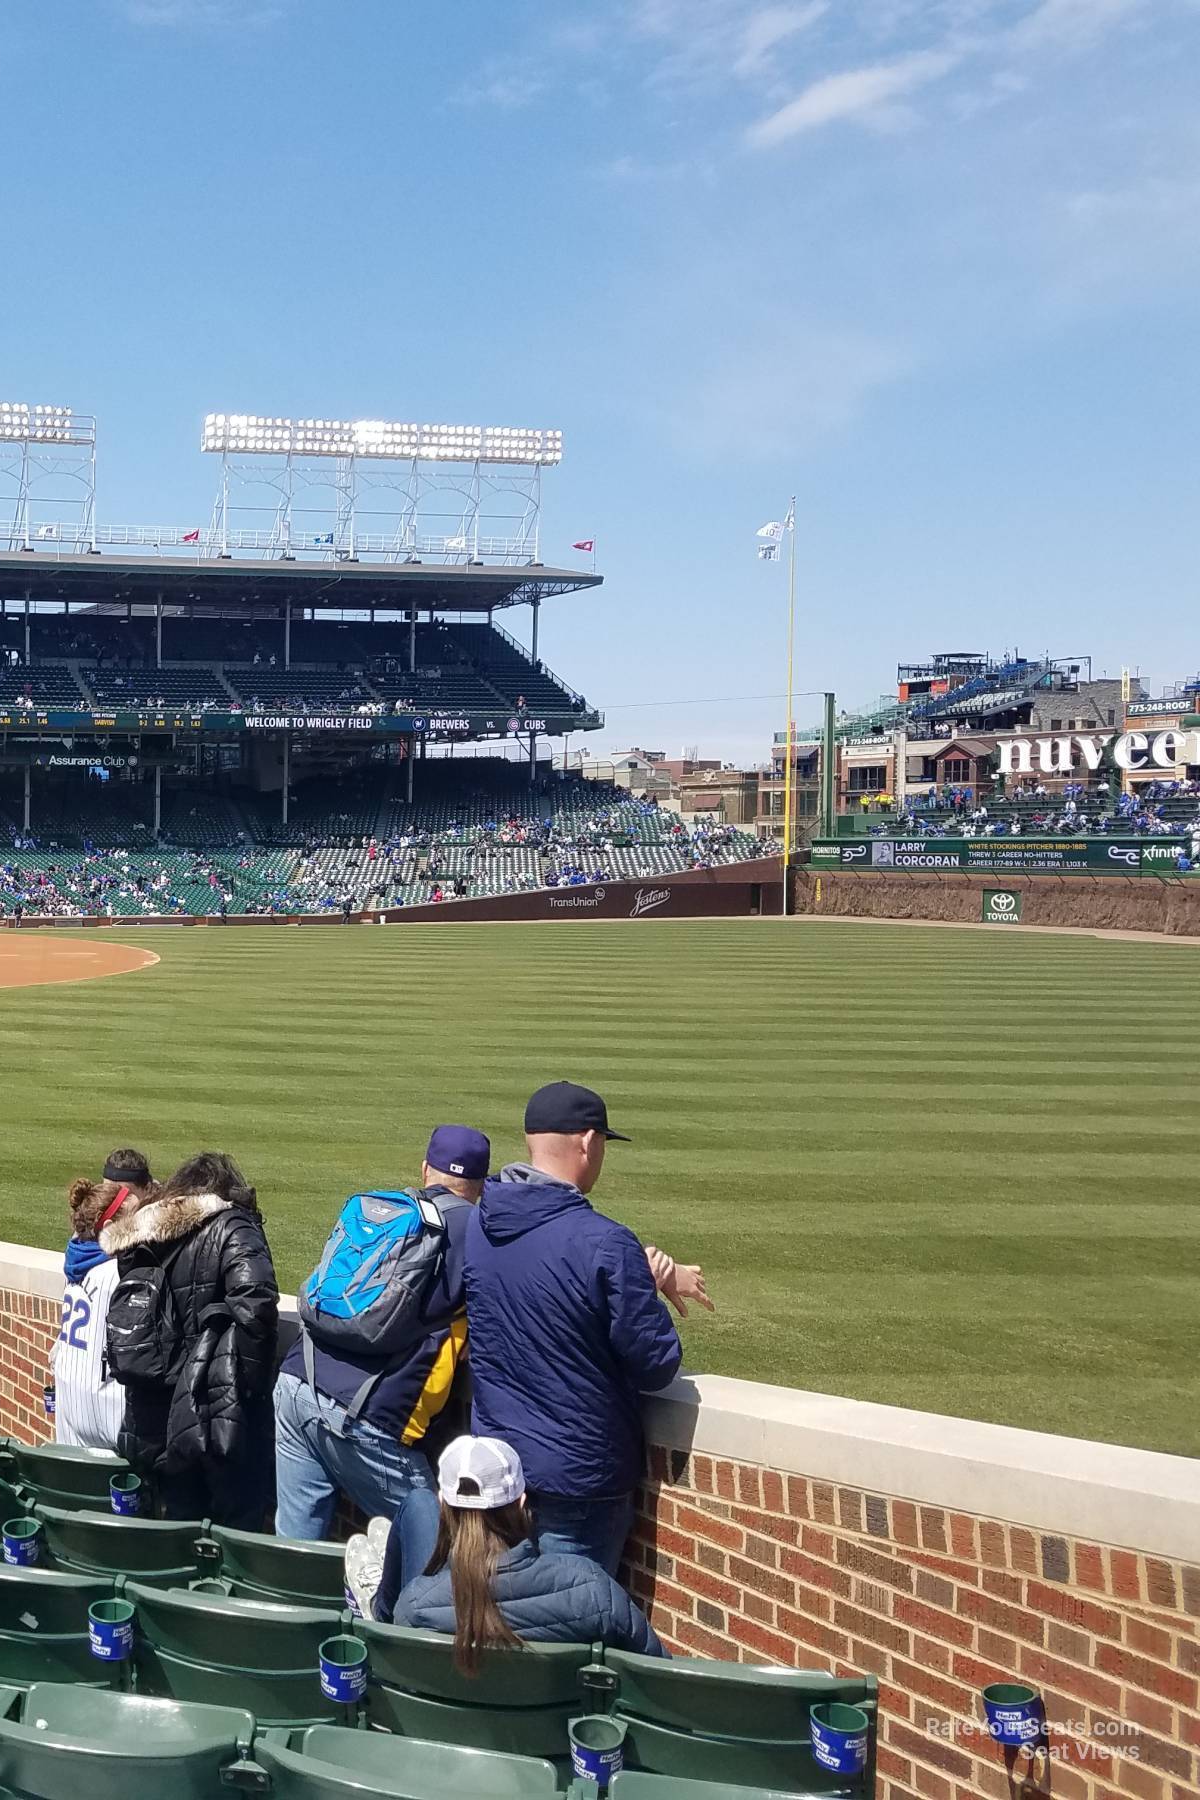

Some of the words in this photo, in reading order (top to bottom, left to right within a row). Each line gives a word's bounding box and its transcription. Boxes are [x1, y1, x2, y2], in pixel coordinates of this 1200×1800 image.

[1128, 701, 1191, 713] 773-248-ROOF
[245, 717, 290, 729] WELCOME
[292, 718, 304, 728] TO
[306, 718, 346, 729] WRIGLEY
[348, 718, 372, 729] FIELD
[430, 719, 470, 730] BREWERS
[524, 720, 546, 730] CUBS
[996, 729, 1200, 774] nuvee
[49, 755, 102, 766] Assurance
[103, 756, 125, 767] Club
[812, 846, 841, 855] HORNITOS
[895, 842, 926, 852] LARRY
[1142, 845, 1177, 861] xfinit
[895, 856, 960, 867] CORCORAN
[549, 897, 598, 907] TransUnion
[629, 888, 672, 917] Jostens
[986, 912, 1019, 922] TOYOTA
[341, 1669, 362, 1680] Hefty
[995, 1711, 1022, 1720] Hefty
[816, 1749, 841, 1768] Hefty
[575, 1763, 597, 1780] Hefty
